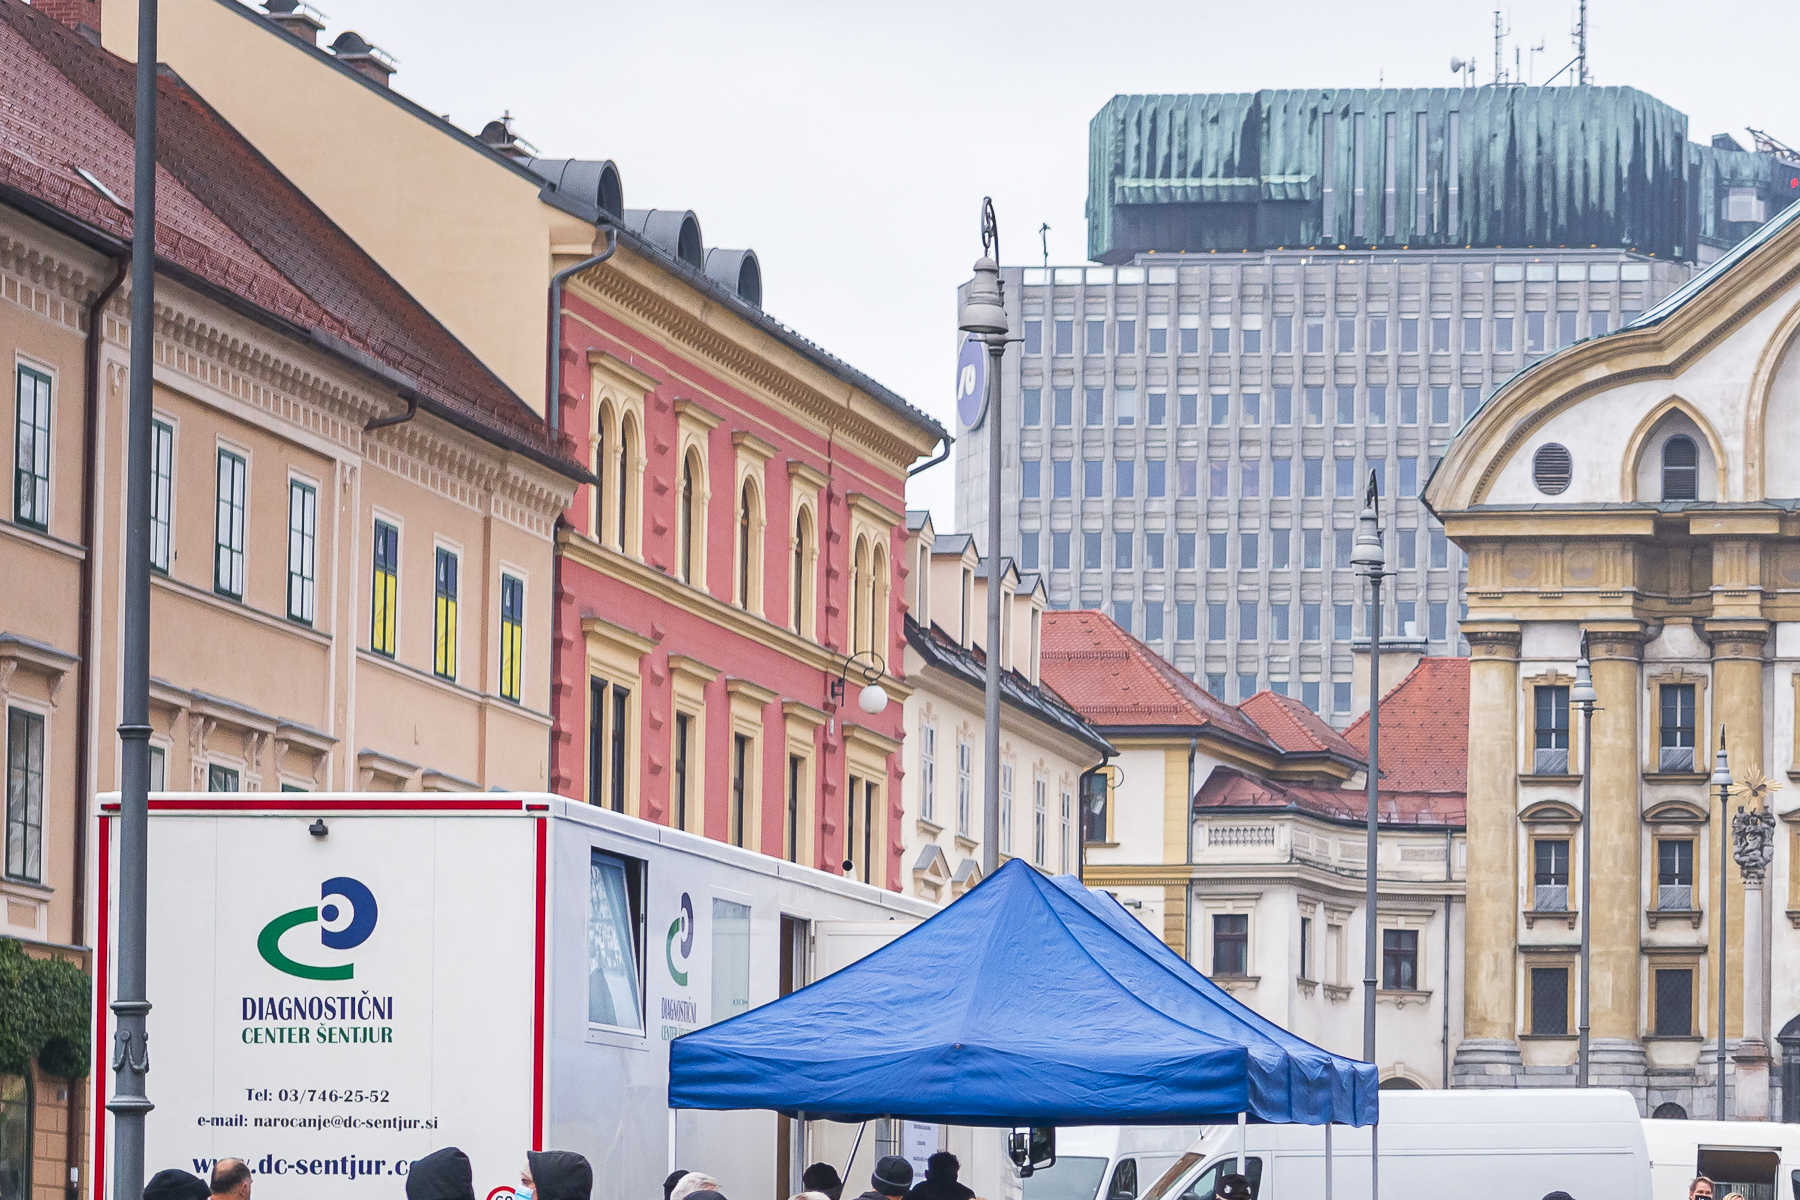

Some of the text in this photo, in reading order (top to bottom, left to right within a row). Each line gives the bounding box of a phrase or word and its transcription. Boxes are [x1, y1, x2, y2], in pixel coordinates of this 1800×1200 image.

[242, 990, 393, 1021] DIAGNOSTIČNI
[241, 1023, 393, 1044] CENTER ŠENTJUR
[246, 1088, 390, 1104] Tel: 03/746-25-52
[197, 1114, 438, 1131] e-mail: narocanje@dc-sentjur.si
[192, 1154, 417, 1180] w.dc-sentjur.c
